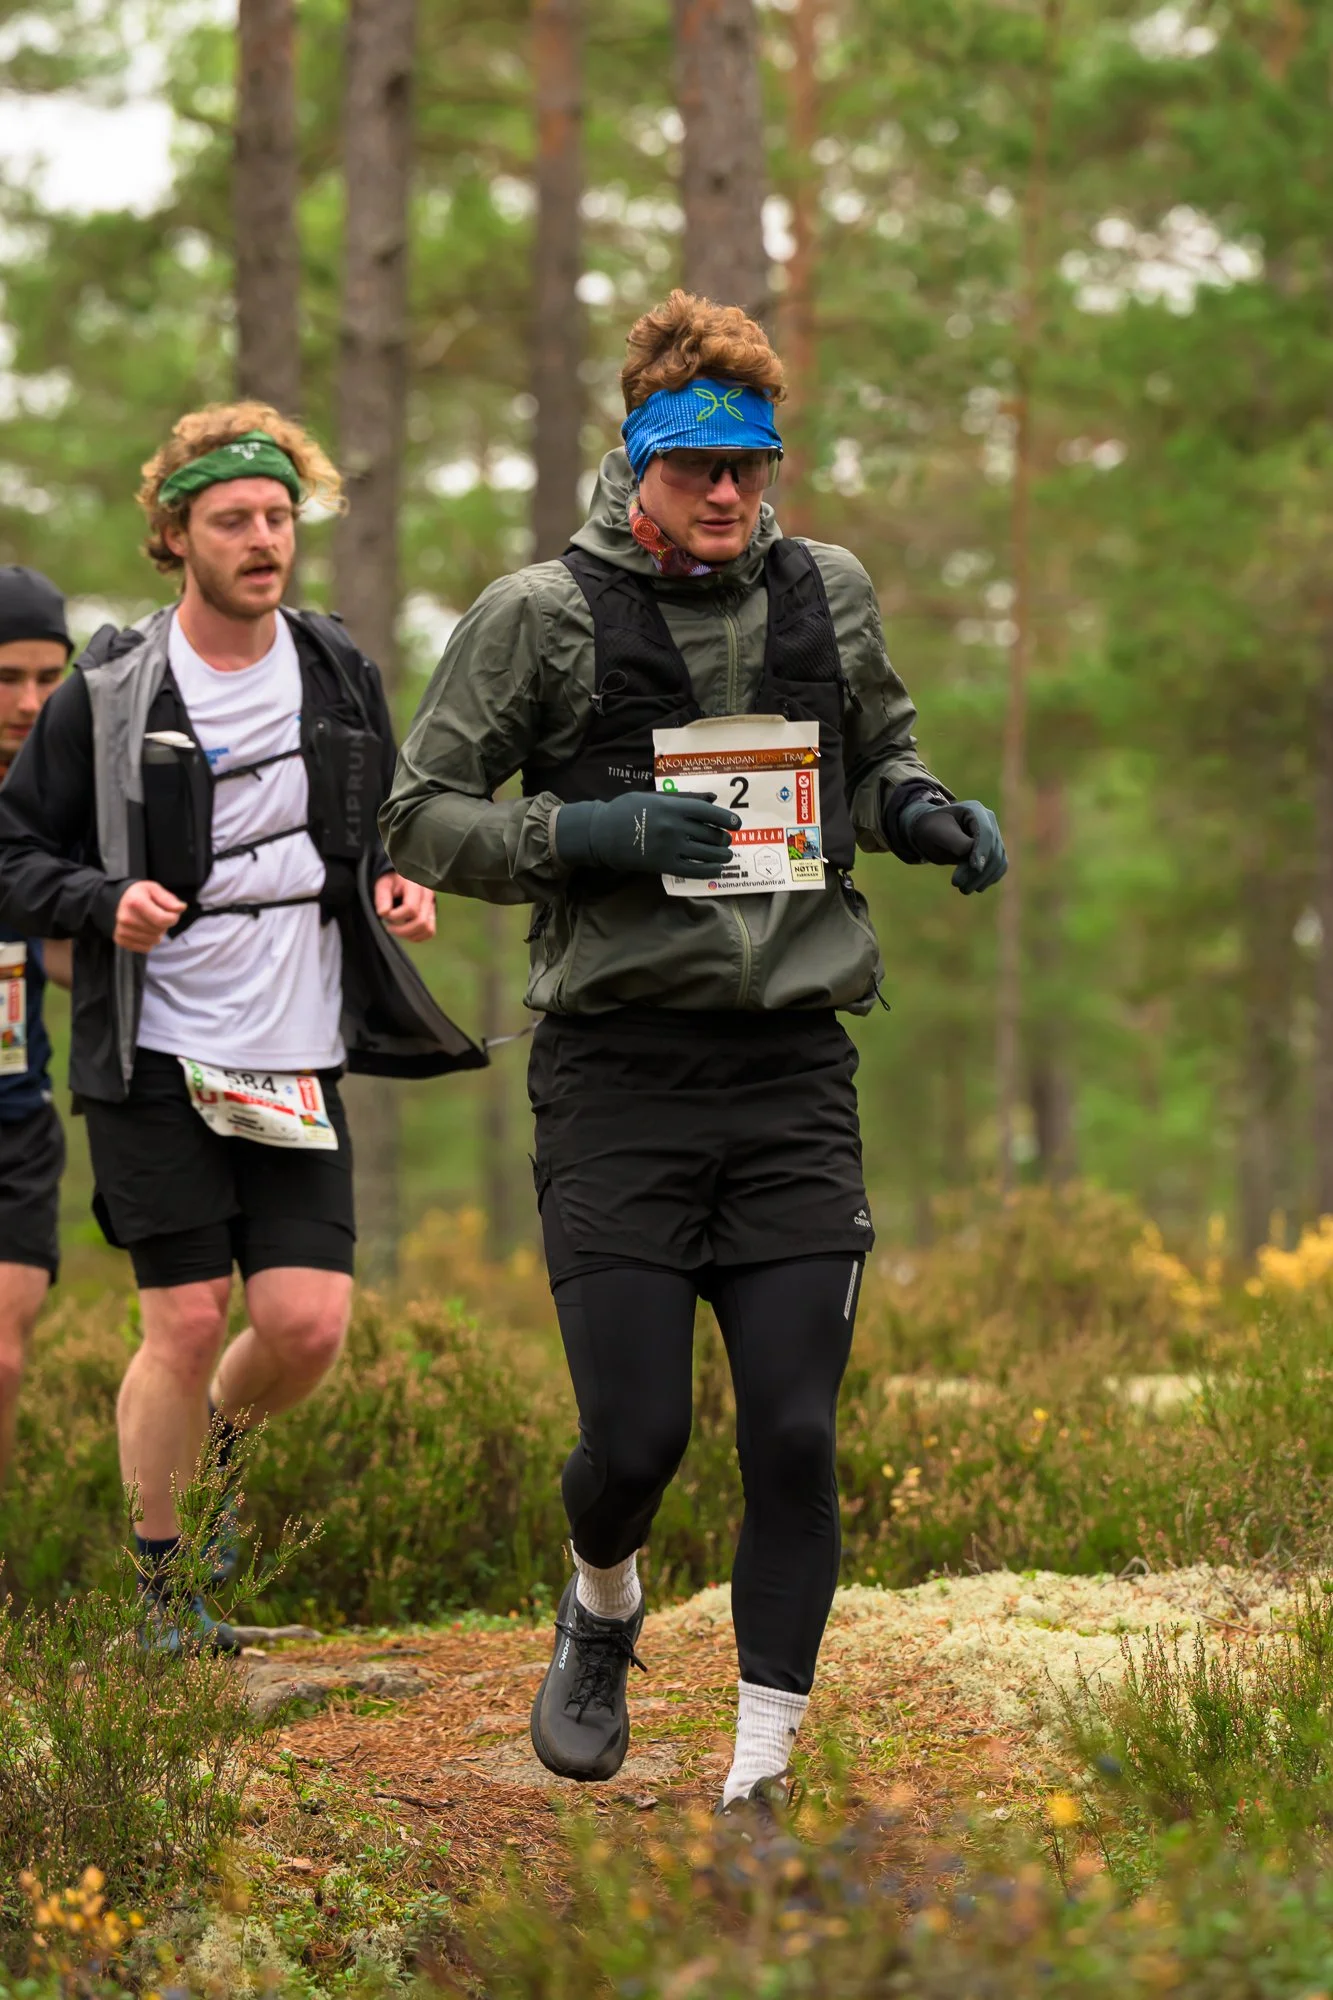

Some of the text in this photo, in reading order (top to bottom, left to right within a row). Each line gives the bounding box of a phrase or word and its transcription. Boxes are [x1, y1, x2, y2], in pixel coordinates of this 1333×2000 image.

[608, 766, 630, 778] TITAN
[345, 734, 366, 847] KIPRUN
[729, 776, 749, 809] 2
[801, 789, 809, 821] CIRCLE
[733, 830, 784, 842] ANMÄLAN
[224, 1070, 277, 1094] 584
